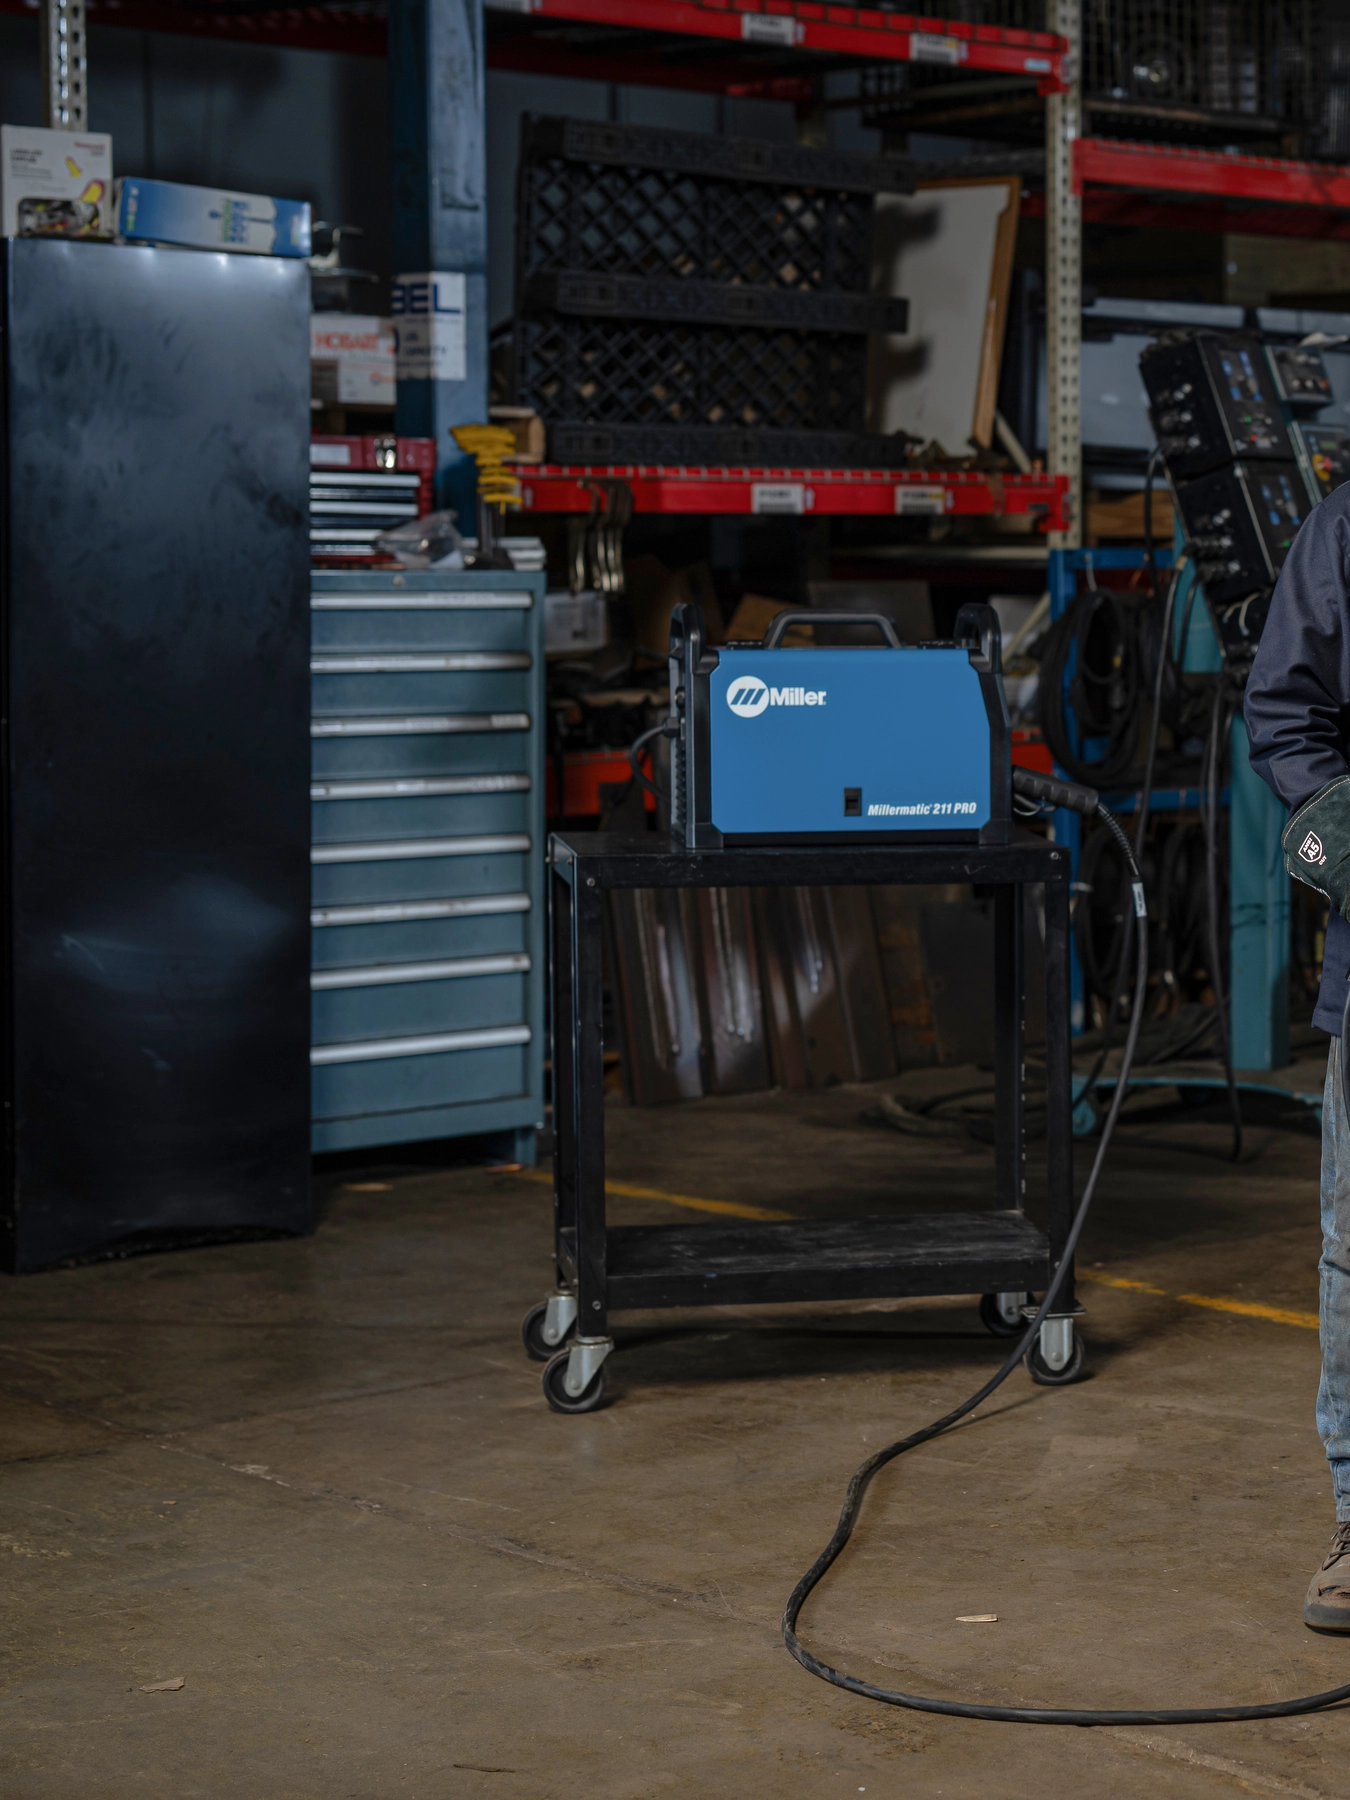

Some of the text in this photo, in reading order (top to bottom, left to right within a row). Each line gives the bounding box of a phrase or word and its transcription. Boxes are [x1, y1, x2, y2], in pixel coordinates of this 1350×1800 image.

[769, 686, 827, 707] Miller
[932, 802, 950, 815] 211
[953, 802, 977, 814] PRO
[1307, 841, 1320, 860] A5
[1318, 855, 1327, 865] CUT
